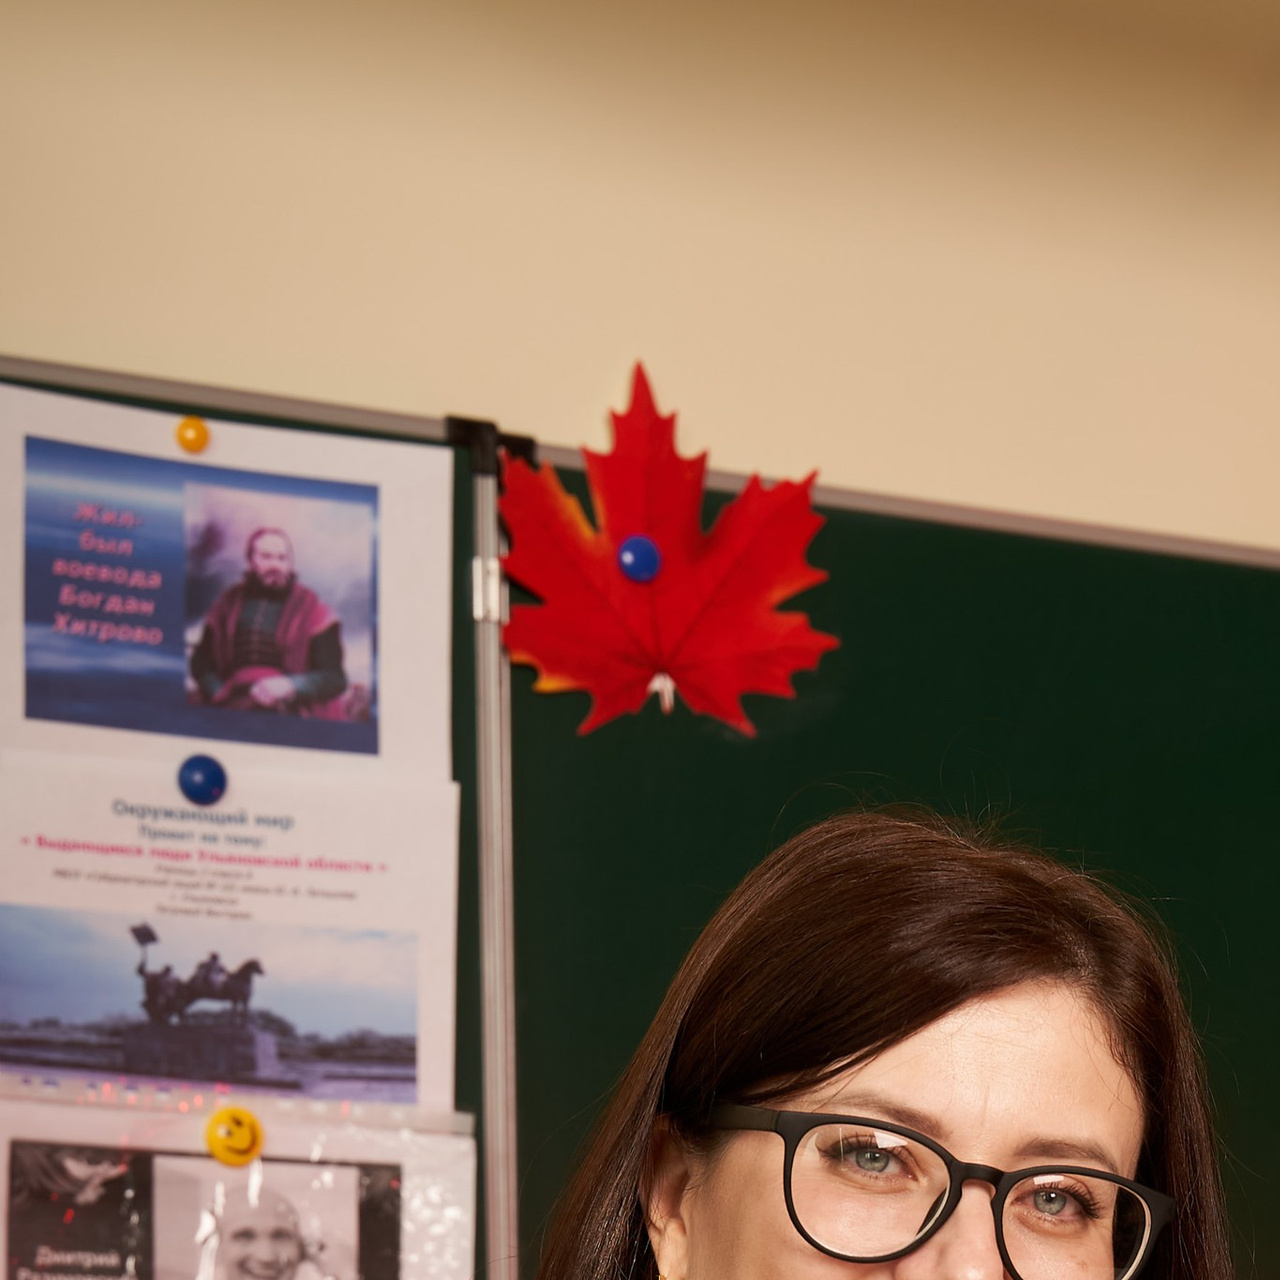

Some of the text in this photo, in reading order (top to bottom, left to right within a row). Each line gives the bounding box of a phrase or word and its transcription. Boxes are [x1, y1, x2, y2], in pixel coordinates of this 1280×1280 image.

[73, 502, 144, 528] Жил-
[79, 529, 133, 556] был
[53, 559, 162, 589] воевода
[59, 584, 155, 616] Богдан
[54, 612, 164, 645] Хитрово
[113, 800, 294, 831] Окружающий мир
[35, 1245, 120, 1269] Дмитрий
